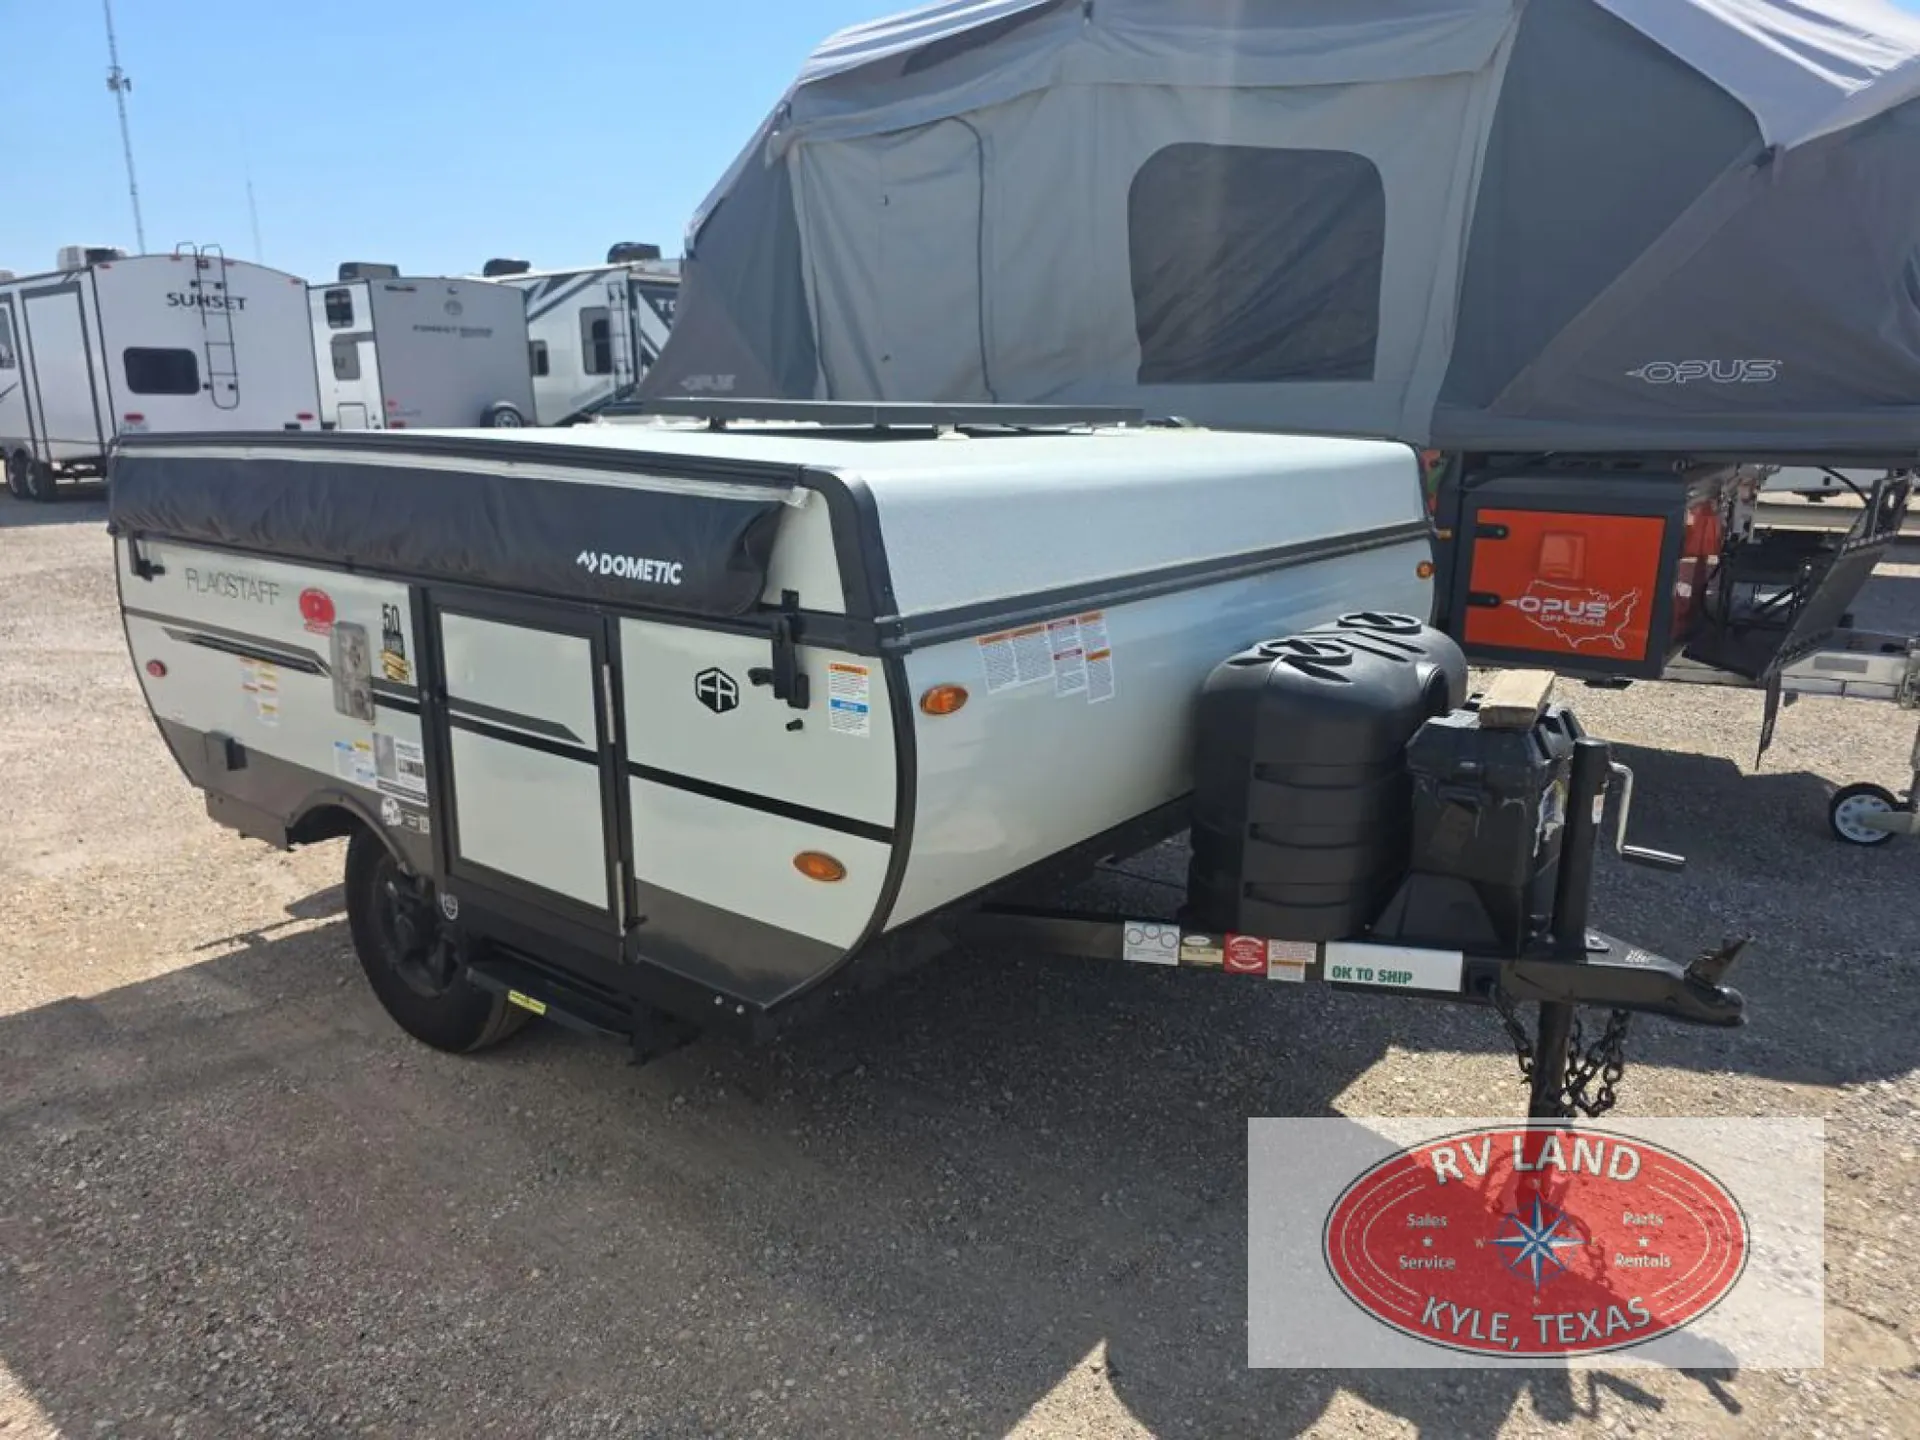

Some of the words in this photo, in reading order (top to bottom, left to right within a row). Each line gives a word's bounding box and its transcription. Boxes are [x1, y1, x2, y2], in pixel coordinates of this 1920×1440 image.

[166, 292, 248, 311] SUNSET
[1642, 359, 1777, 384] OPUS
[600, 552, 683, 585] DOMETIC
[185, 567, 280, 605] FLAGSTAFF
[1519, 595, 1608, 618] OPUS
[1331, 965, 1353, 979] OK
[1355, 967, 1374, 981] TO
[1377, 969, 1414, 985] SHIP
